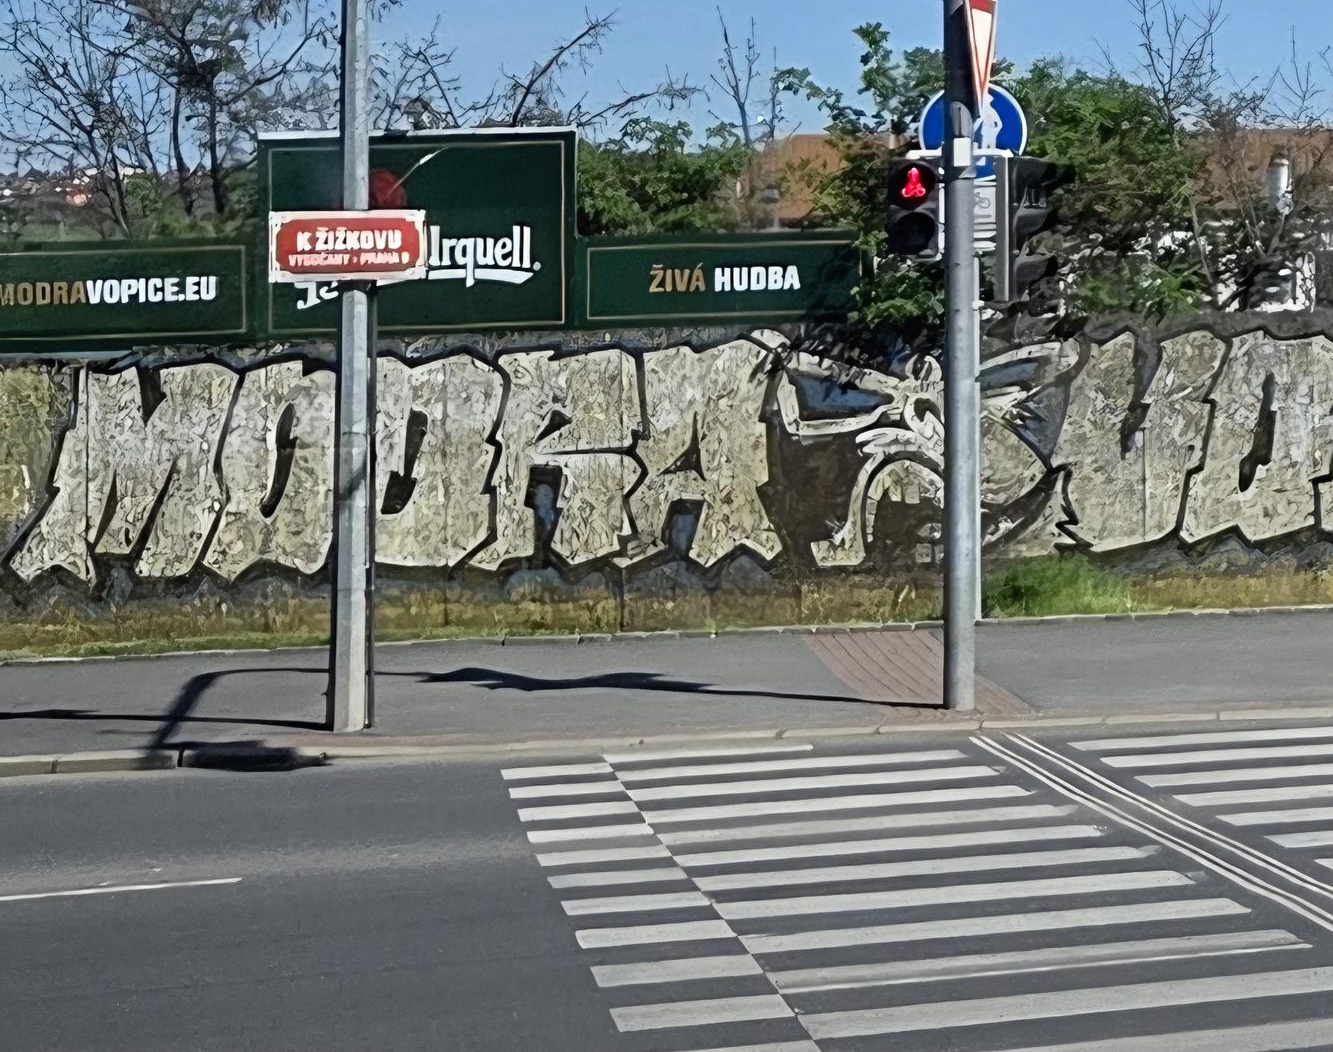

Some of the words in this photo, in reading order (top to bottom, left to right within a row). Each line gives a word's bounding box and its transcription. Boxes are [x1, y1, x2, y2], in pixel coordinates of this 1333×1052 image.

[297, 232, 312, 252] K
[315, 227, 402, 251] ŽIŽKOVU
[648, 262, 706, 293] ŽIVÁ
[714, 265, 801, 292] HUDBA
